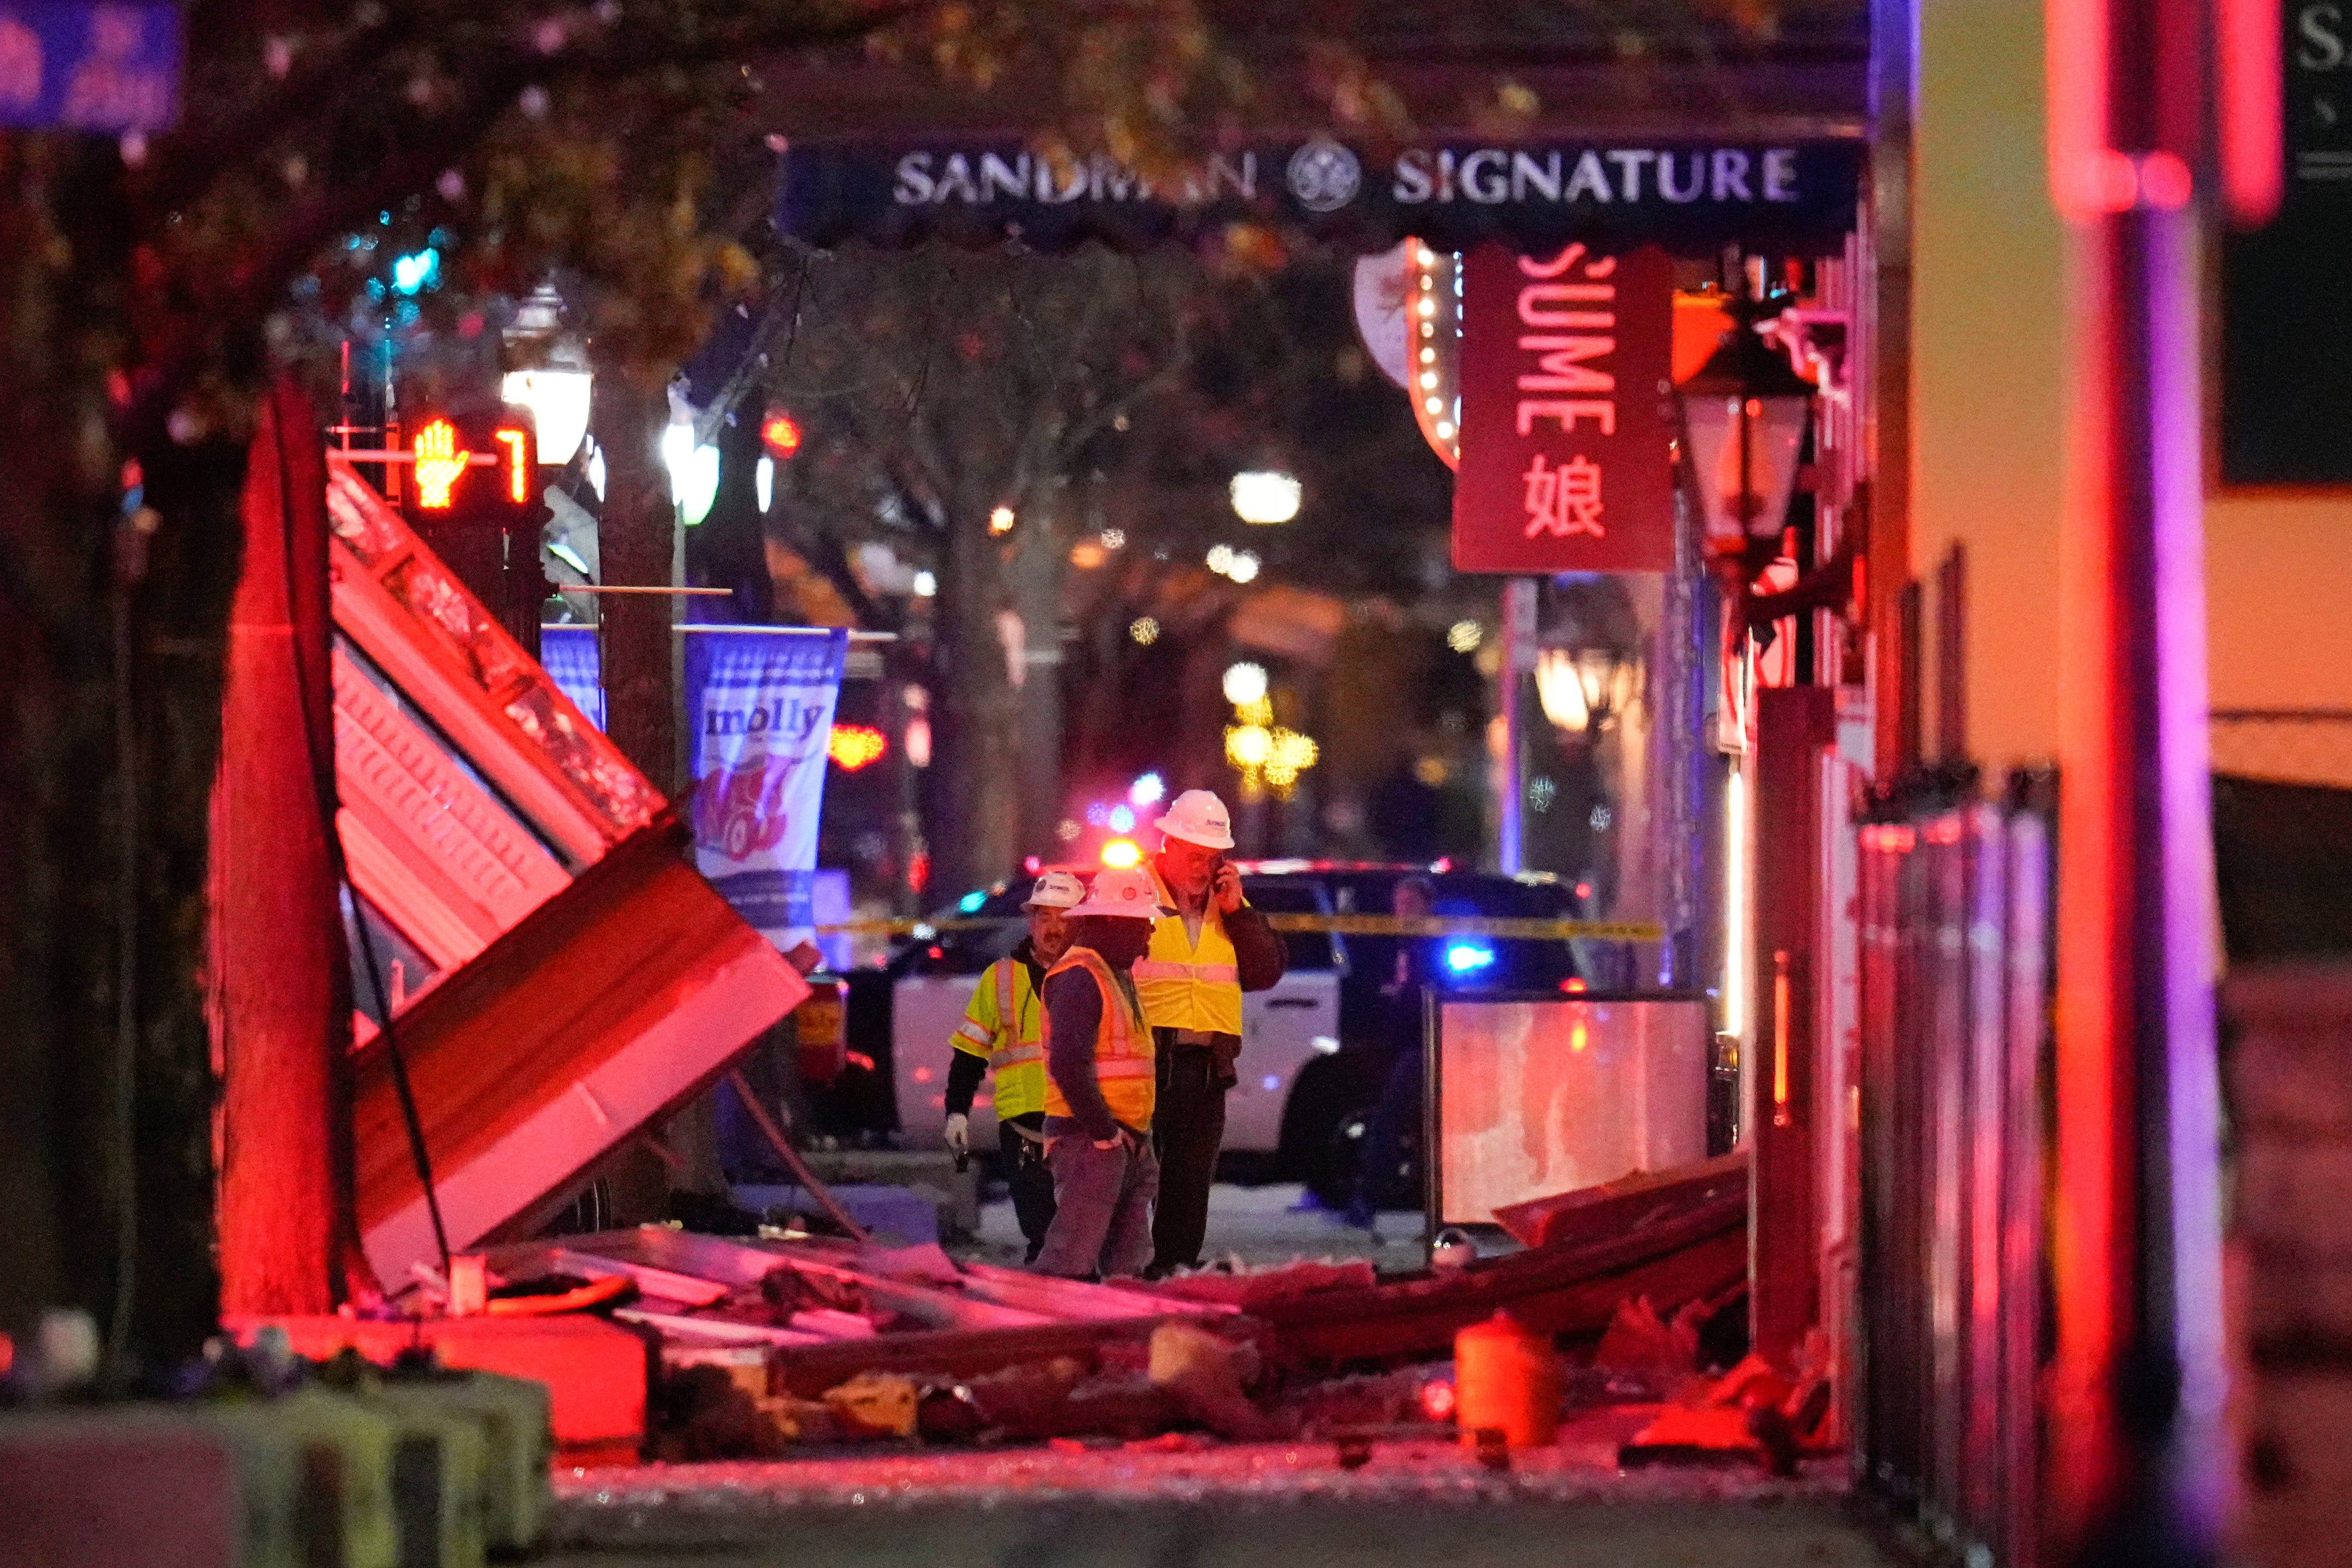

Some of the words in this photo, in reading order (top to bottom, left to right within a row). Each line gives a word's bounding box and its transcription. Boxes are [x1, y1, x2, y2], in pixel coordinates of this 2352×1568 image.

[2299, 3, 2352, 71] S
[892, 150, 1258, 203] SANDMN
[1392, 148, 1800, 203] SIGNATURE
[1522, 454, 1605, 539] 娘
[706, 697, 825, 742] molly
